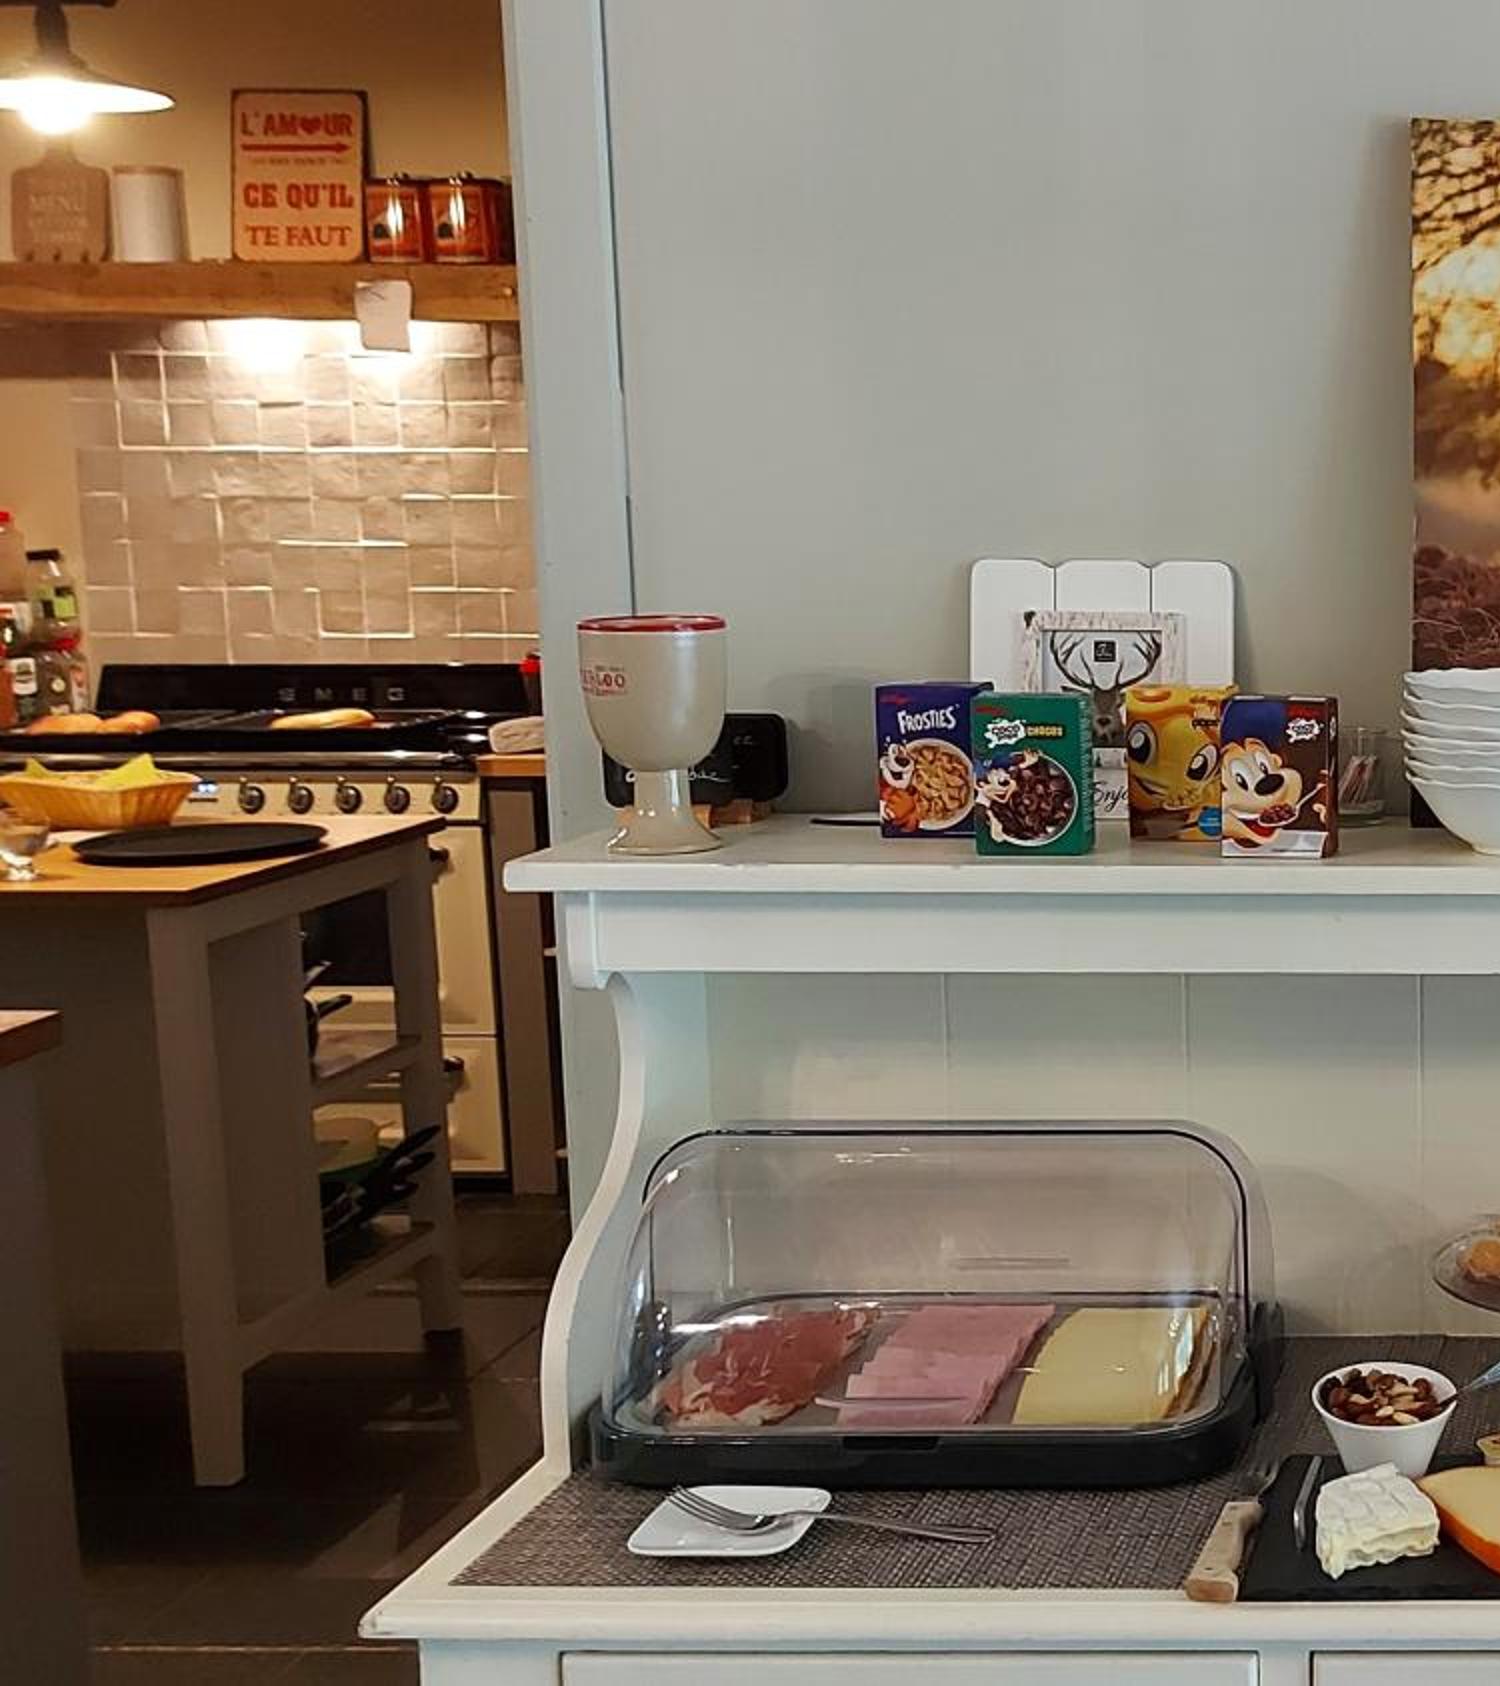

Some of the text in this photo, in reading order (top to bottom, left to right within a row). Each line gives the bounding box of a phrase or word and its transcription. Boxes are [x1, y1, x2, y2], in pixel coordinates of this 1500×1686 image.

[243, 183, 354, 210] CE QU'IL
[245, 225, 352, 246] TE FAUT
[279, 687, 404, 701] SMEG
[898, 706, 956, 734] FROSTIES
